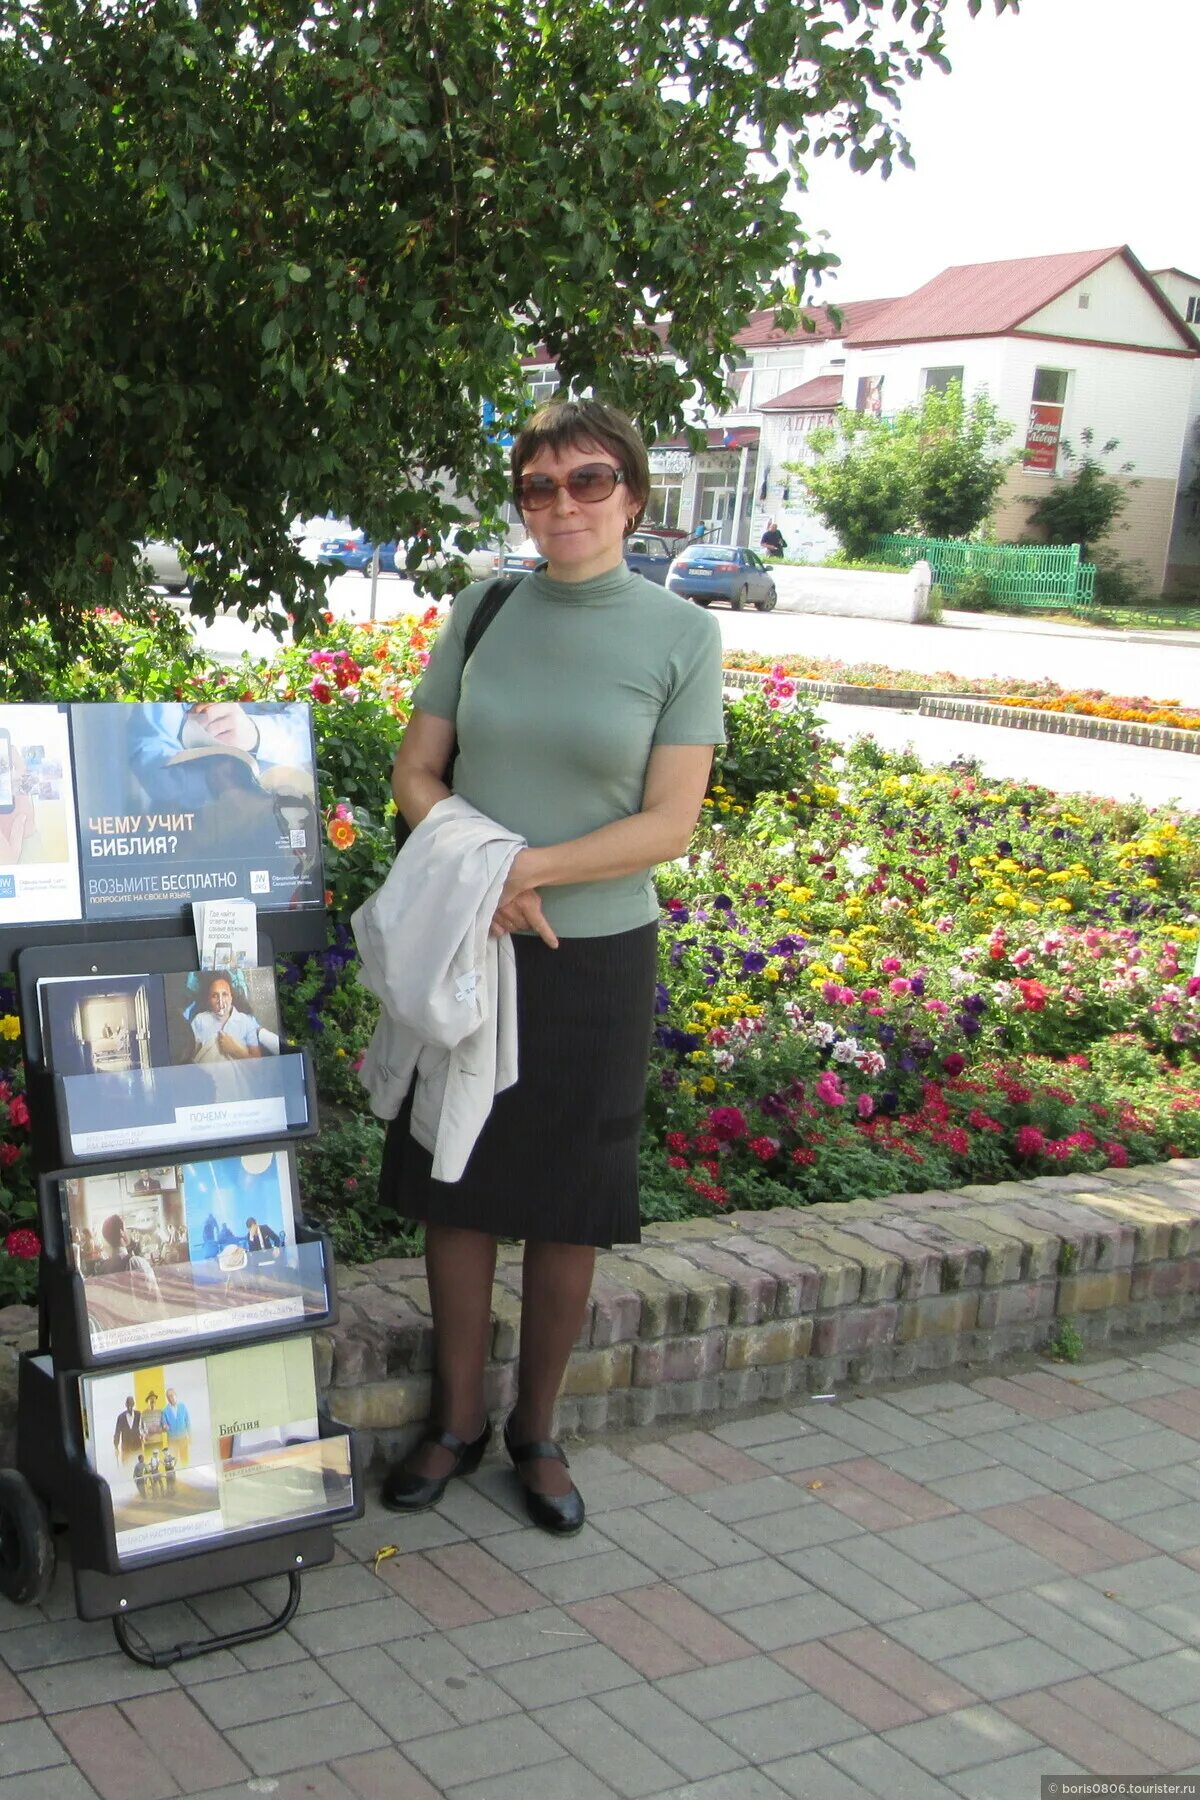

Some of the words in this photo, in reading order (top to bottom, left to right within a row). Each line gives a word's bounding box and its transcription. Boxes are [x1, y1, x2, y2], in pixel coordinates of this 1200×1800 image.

[783, 413, 834, 431] АПТЕК
[88, 815, 141, 834] ЧЕМУ
[146, 813, 195, 832] УЧИТ
[90, 836, 178, 857] БИБЛИЯ?
[88, 876, 158, 895] ВОЗЬМИТЕ
[161, 871, 237, 891] БЕСПЛАТНО
[90, 895, 132, 904] ПОПРОСИТЕ
[169, 891, 191, 899] ЯЗЫКЕ
[219, 1420, 260, 1436] Библия
